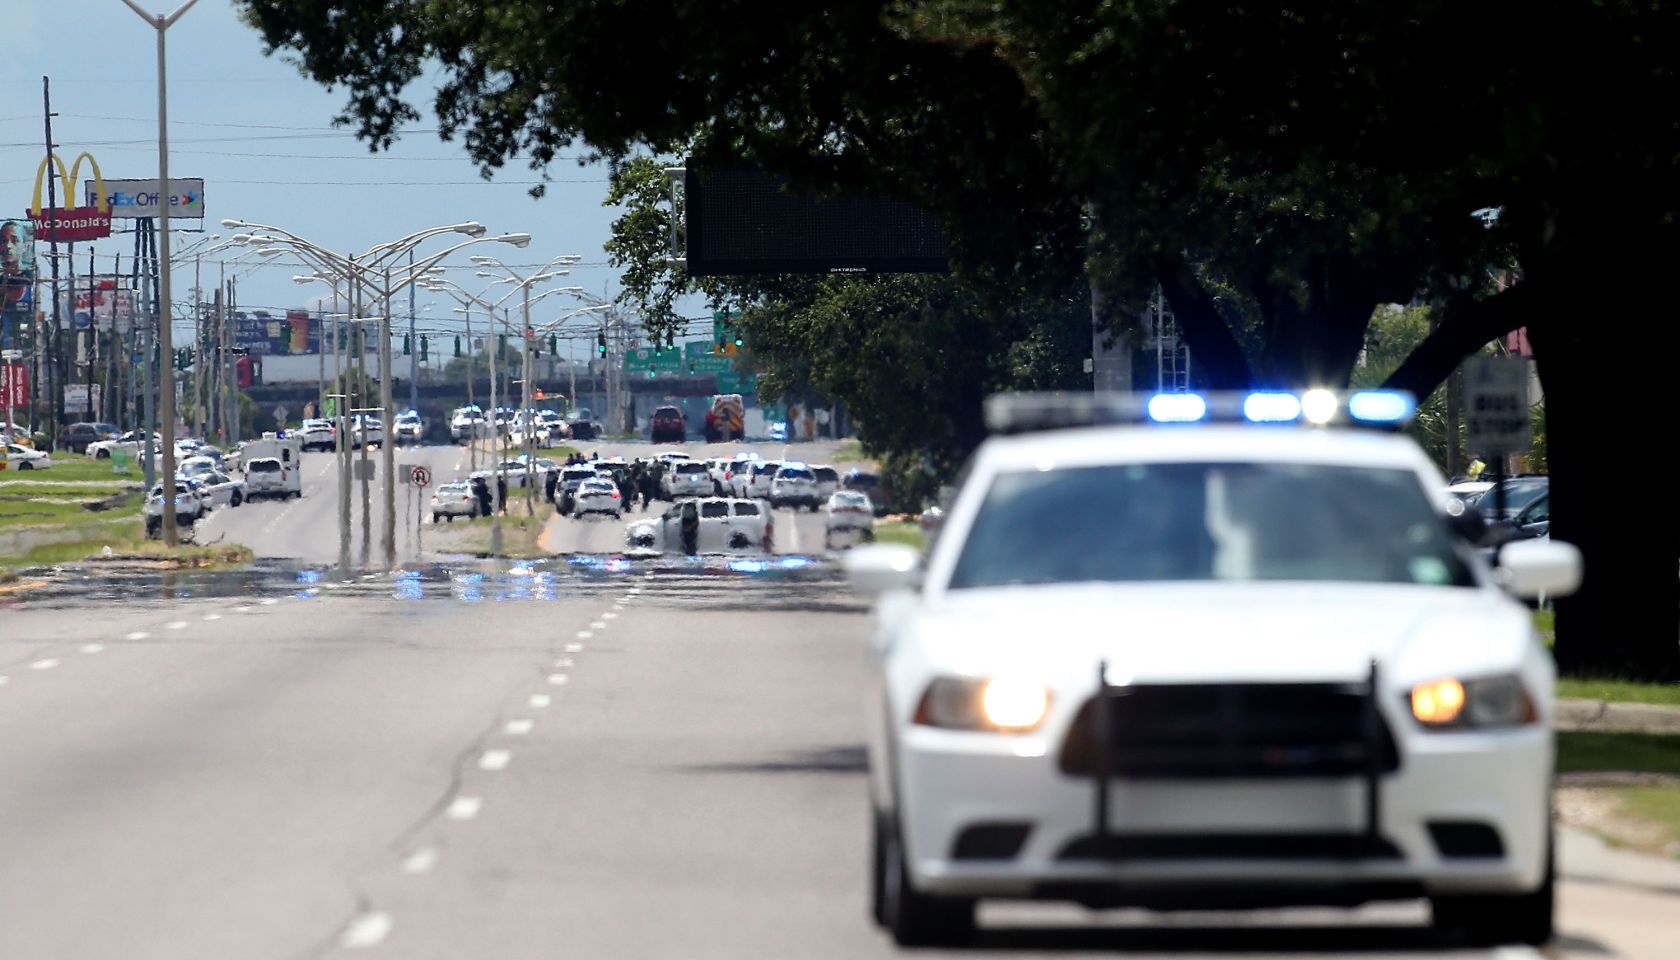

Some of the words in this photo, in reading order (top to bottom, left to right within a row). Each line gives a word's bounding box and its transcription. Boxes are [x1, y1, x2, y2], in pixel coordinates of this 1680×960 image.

[34, 217, 109, 230] McDonald's
[1475, 395, 1518, 411] BUS
[1470, 417, 1524, 435] STOP
